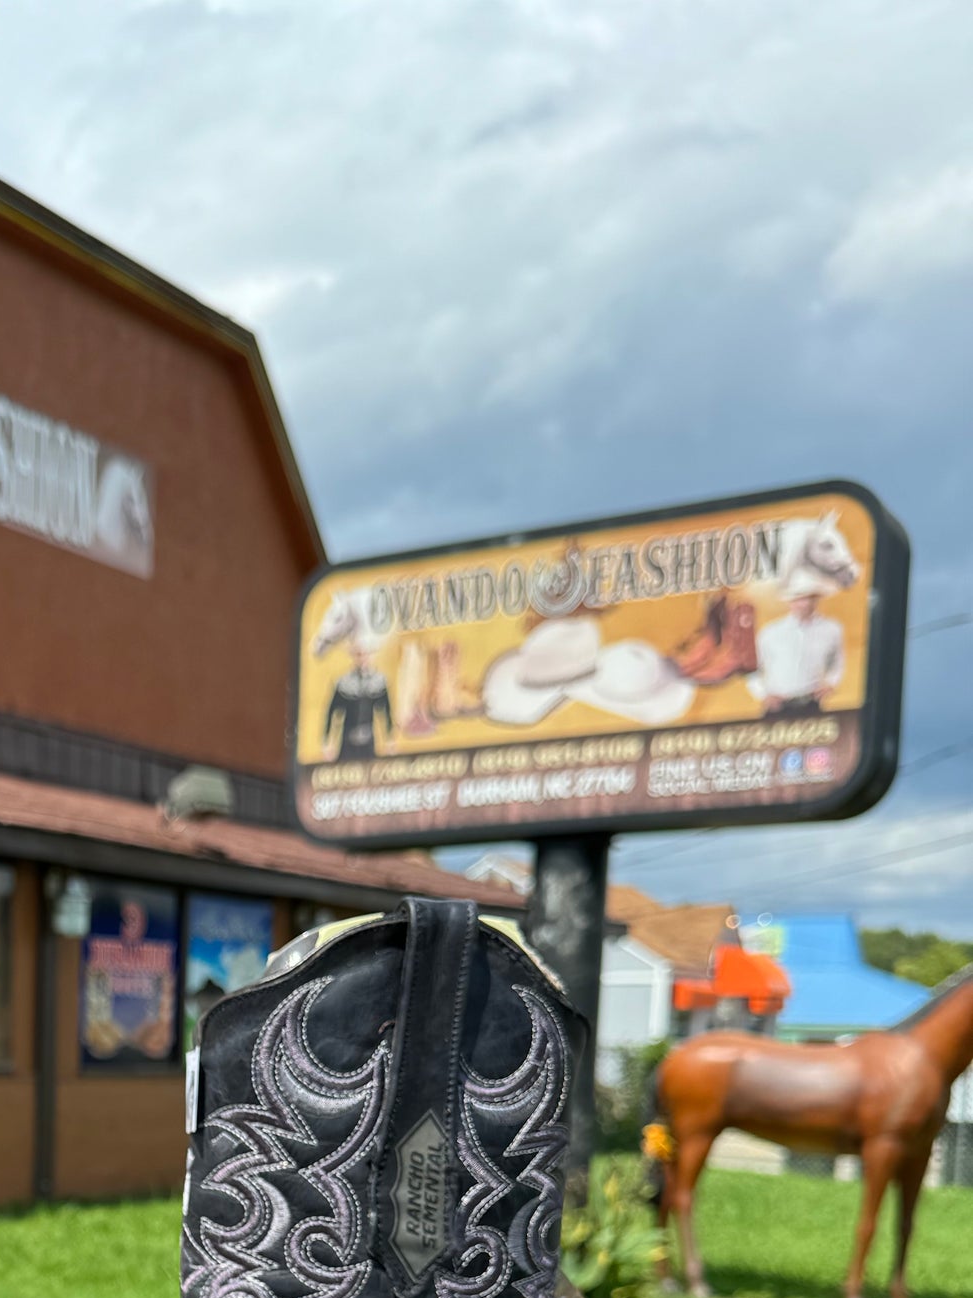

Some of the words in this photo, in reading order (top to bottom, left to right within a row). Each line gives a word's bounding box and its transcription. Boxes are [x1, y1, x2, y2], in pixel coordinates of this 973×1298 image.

[370, 559, 525, 634] OVANDO
[584, 521, 785, 607] FASHION
[406, 1151, 426, 1236] RANCHO
[422, 1141, 446, 1249] SEMENTAL
